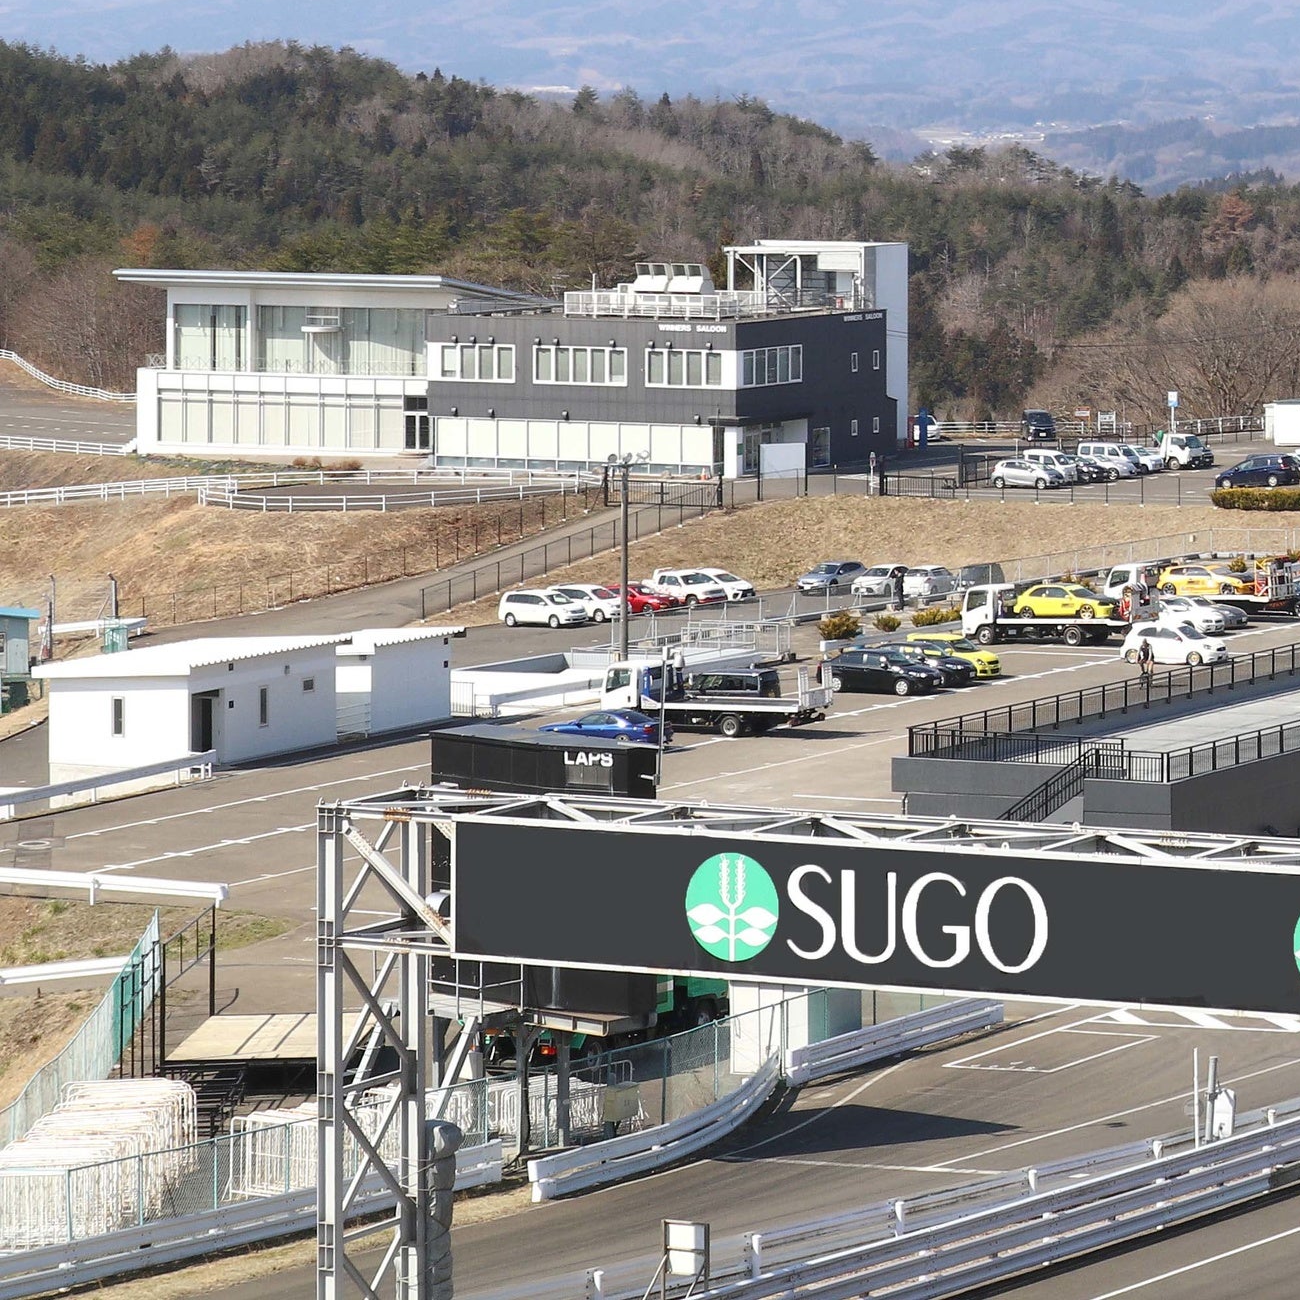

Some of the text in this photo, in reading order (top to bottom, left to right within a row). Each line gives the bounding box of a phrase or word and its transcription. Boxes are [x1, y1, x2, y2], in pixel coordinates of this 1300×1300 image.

[658, 324, 727, 333] WINNERS SALOON
[563, 751, 613, 767] LAPS
[785, 864, 1048, 974] SUGO
